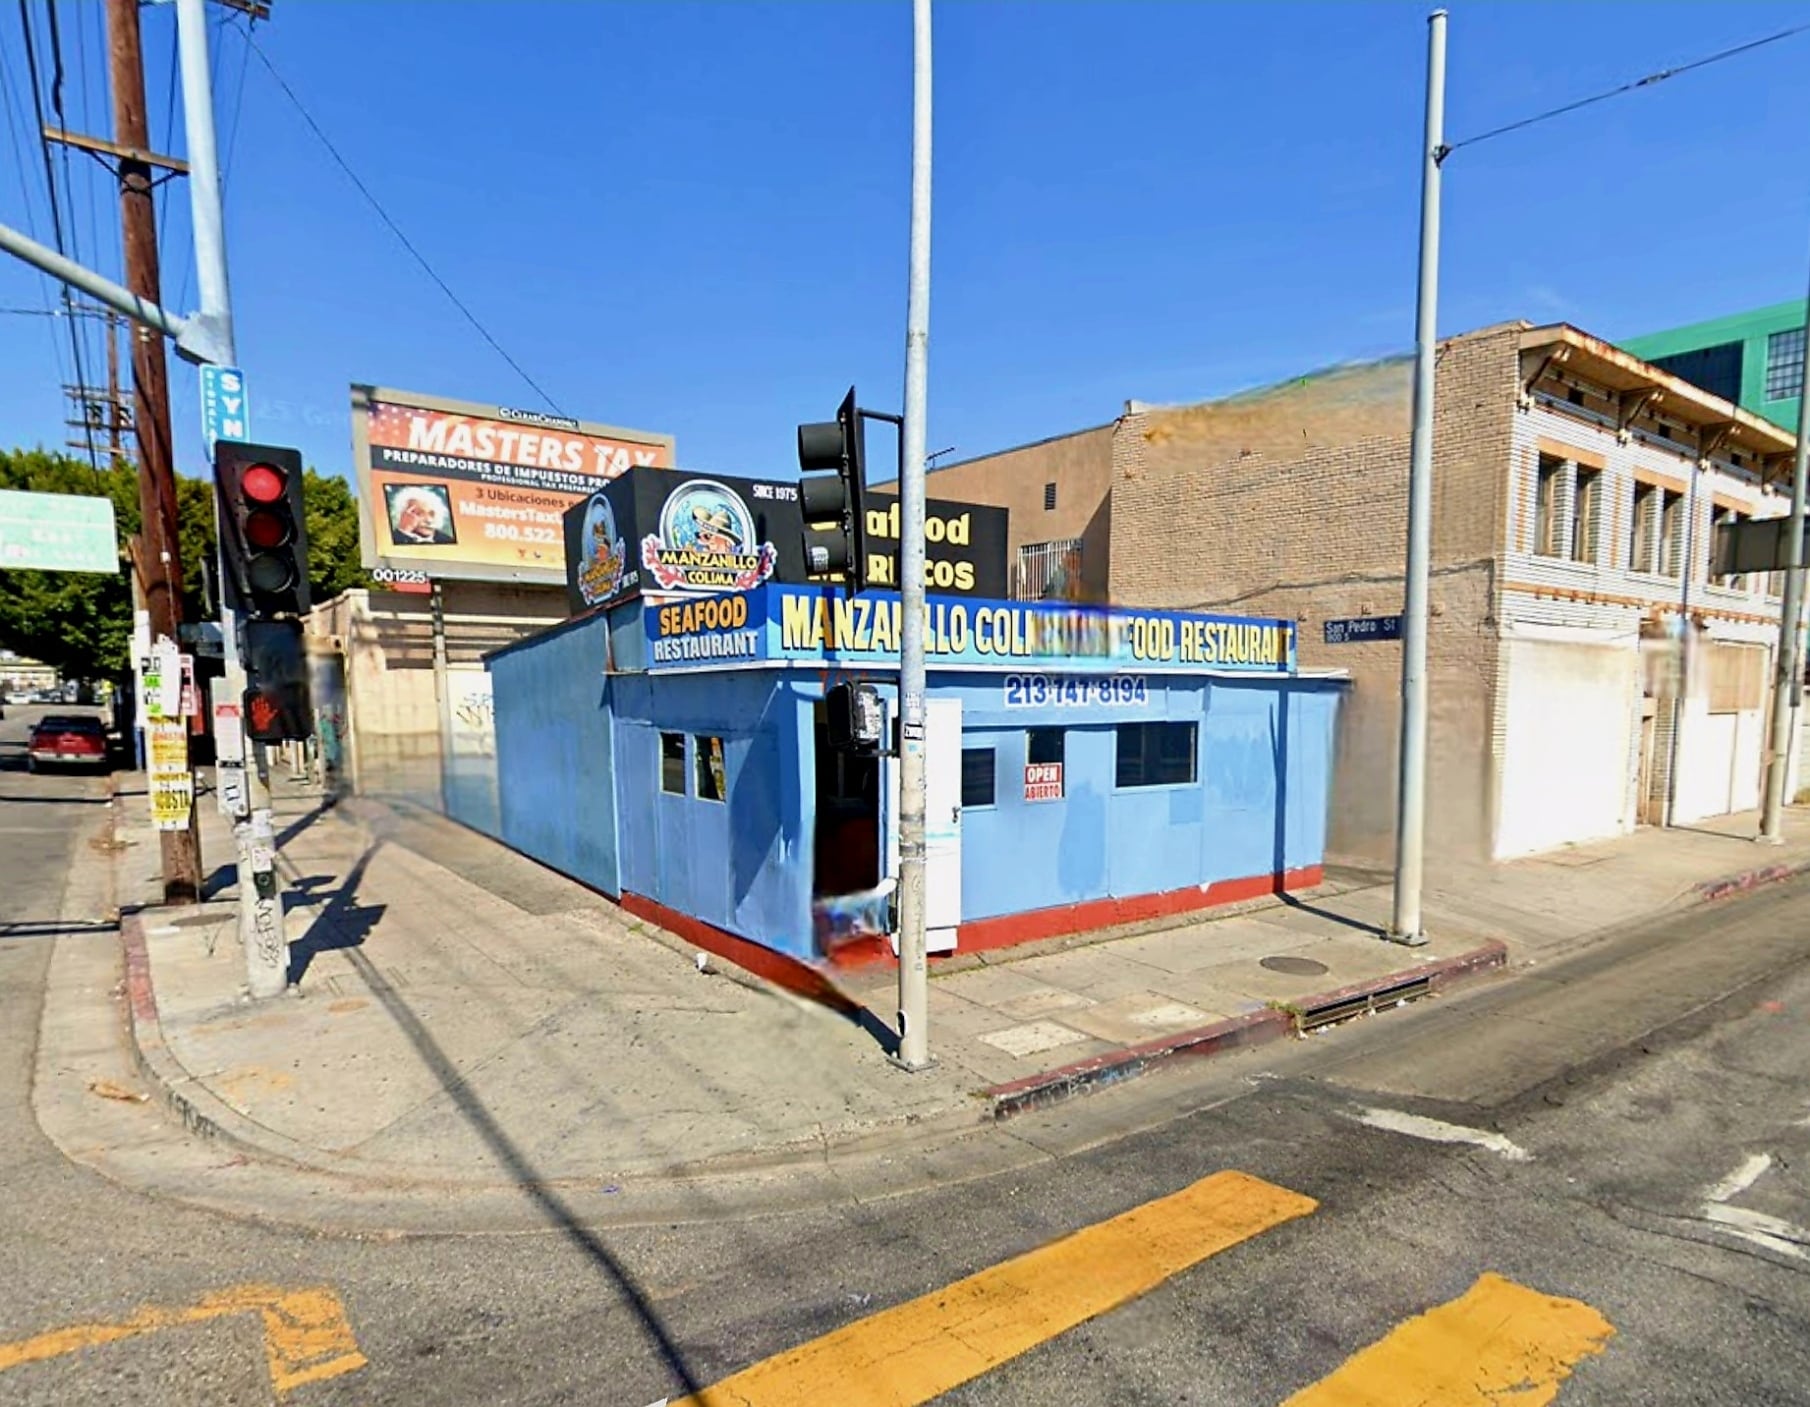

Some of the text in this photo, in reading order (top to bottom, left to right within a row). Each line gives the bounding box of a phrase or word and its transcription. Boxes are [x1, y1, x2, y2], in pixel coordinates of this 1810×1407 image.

[221, 373, 243, 438] SYN
[409, 416, 656, 476] MASTERS TAX
[383, 449, 491, 474] PREPARADORES
[494, 464, 511, 476] DE
[514, 465, 585, 485] IMPUESTOS
[476, 487, 484, 498] 3
[487, 489, 565, 508] Ubicaciones
[753, 484, 798, 501] SINCE 1975
[459, 501, 564, 525] MastersTax
[485, 523, 563, 544] 800.522.
[661, 550, 758, 571] MANZANILLO
[373, 569, 426, 584] 001225
[687, 571, 734, 585] COLIMA
[659, 595, 747, 636] SEAFOOD
[1326, 619, 1396, 633] San Pedro St
[781, 594, 967, 655] MANZANLLO
[1180, 619, 1293, 665] RESTAURANT
[654, 630, 759, 662] RESTAURANT
[1027, 767, 1058, 783] OPEN
[1025, 785, 1060, 799] ABIERTO
